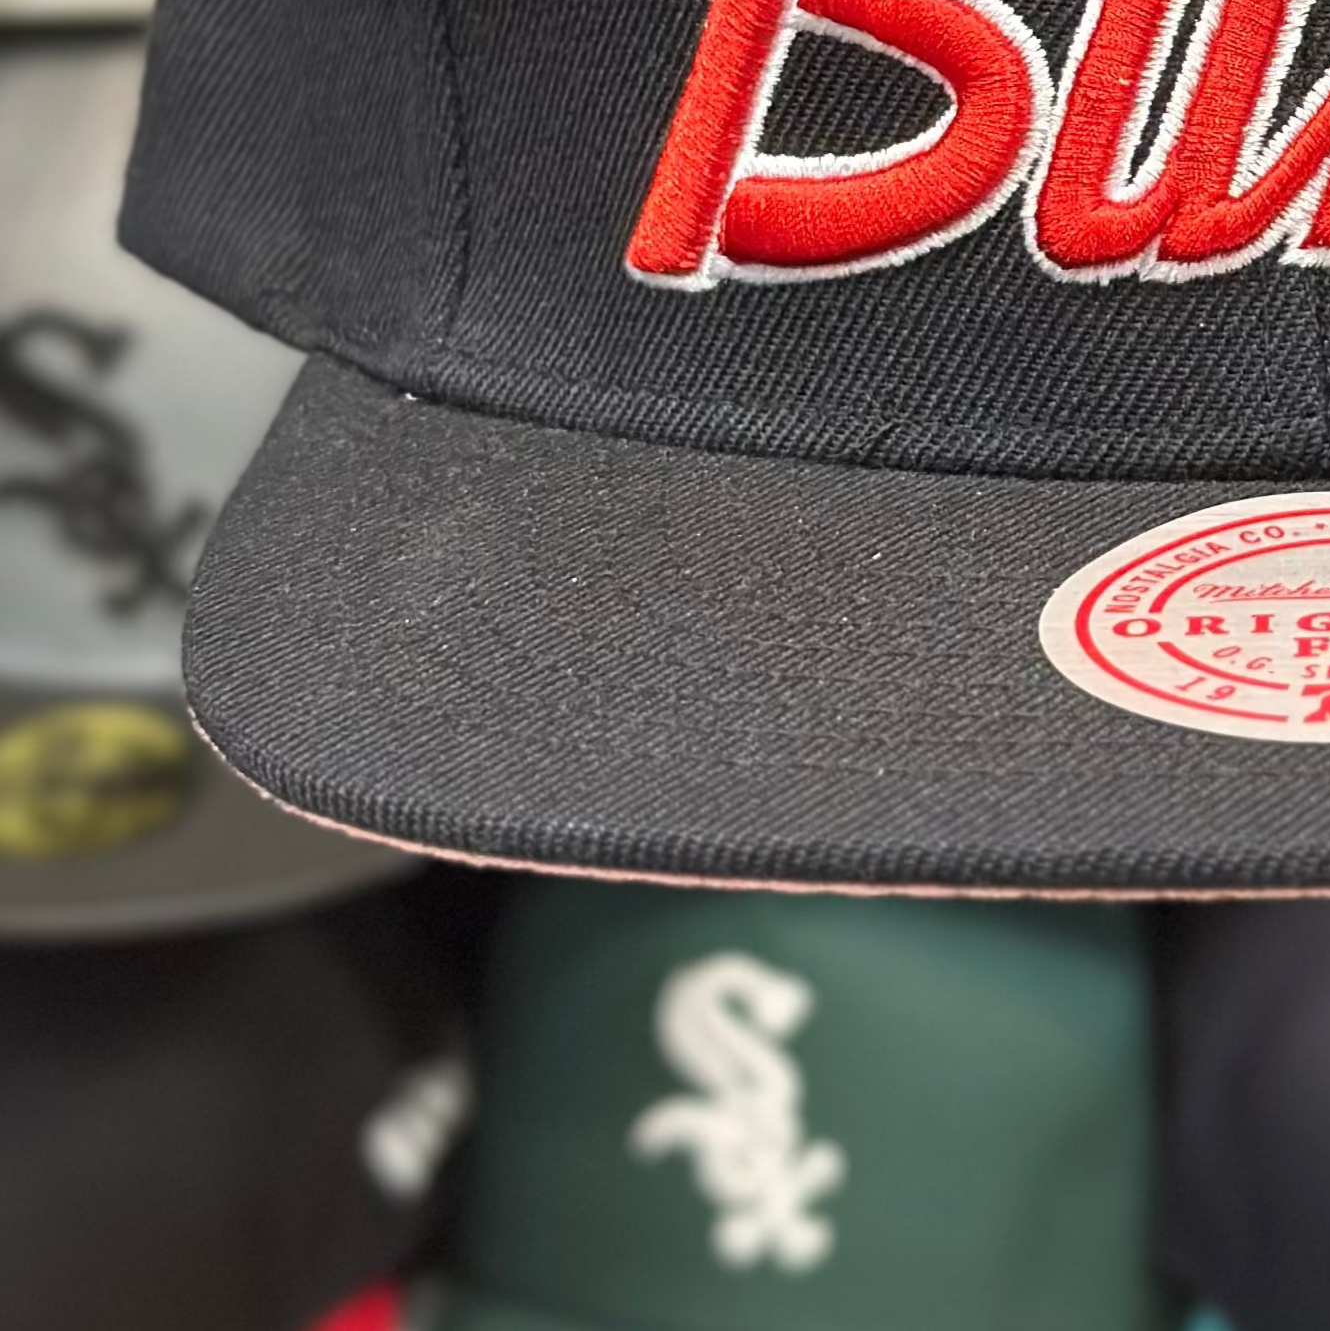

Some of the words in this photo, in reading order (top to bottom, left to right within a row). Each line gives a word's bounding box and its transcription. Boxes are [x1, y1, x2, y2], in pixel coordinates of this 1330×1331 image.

[1103, 541, 1231, 613] NOSTALGIA
[1238, 525, 1302, 545] CO.
[1212, 645, 1275, 674] O.G.
[1175, 676, 1237, 701] 19
